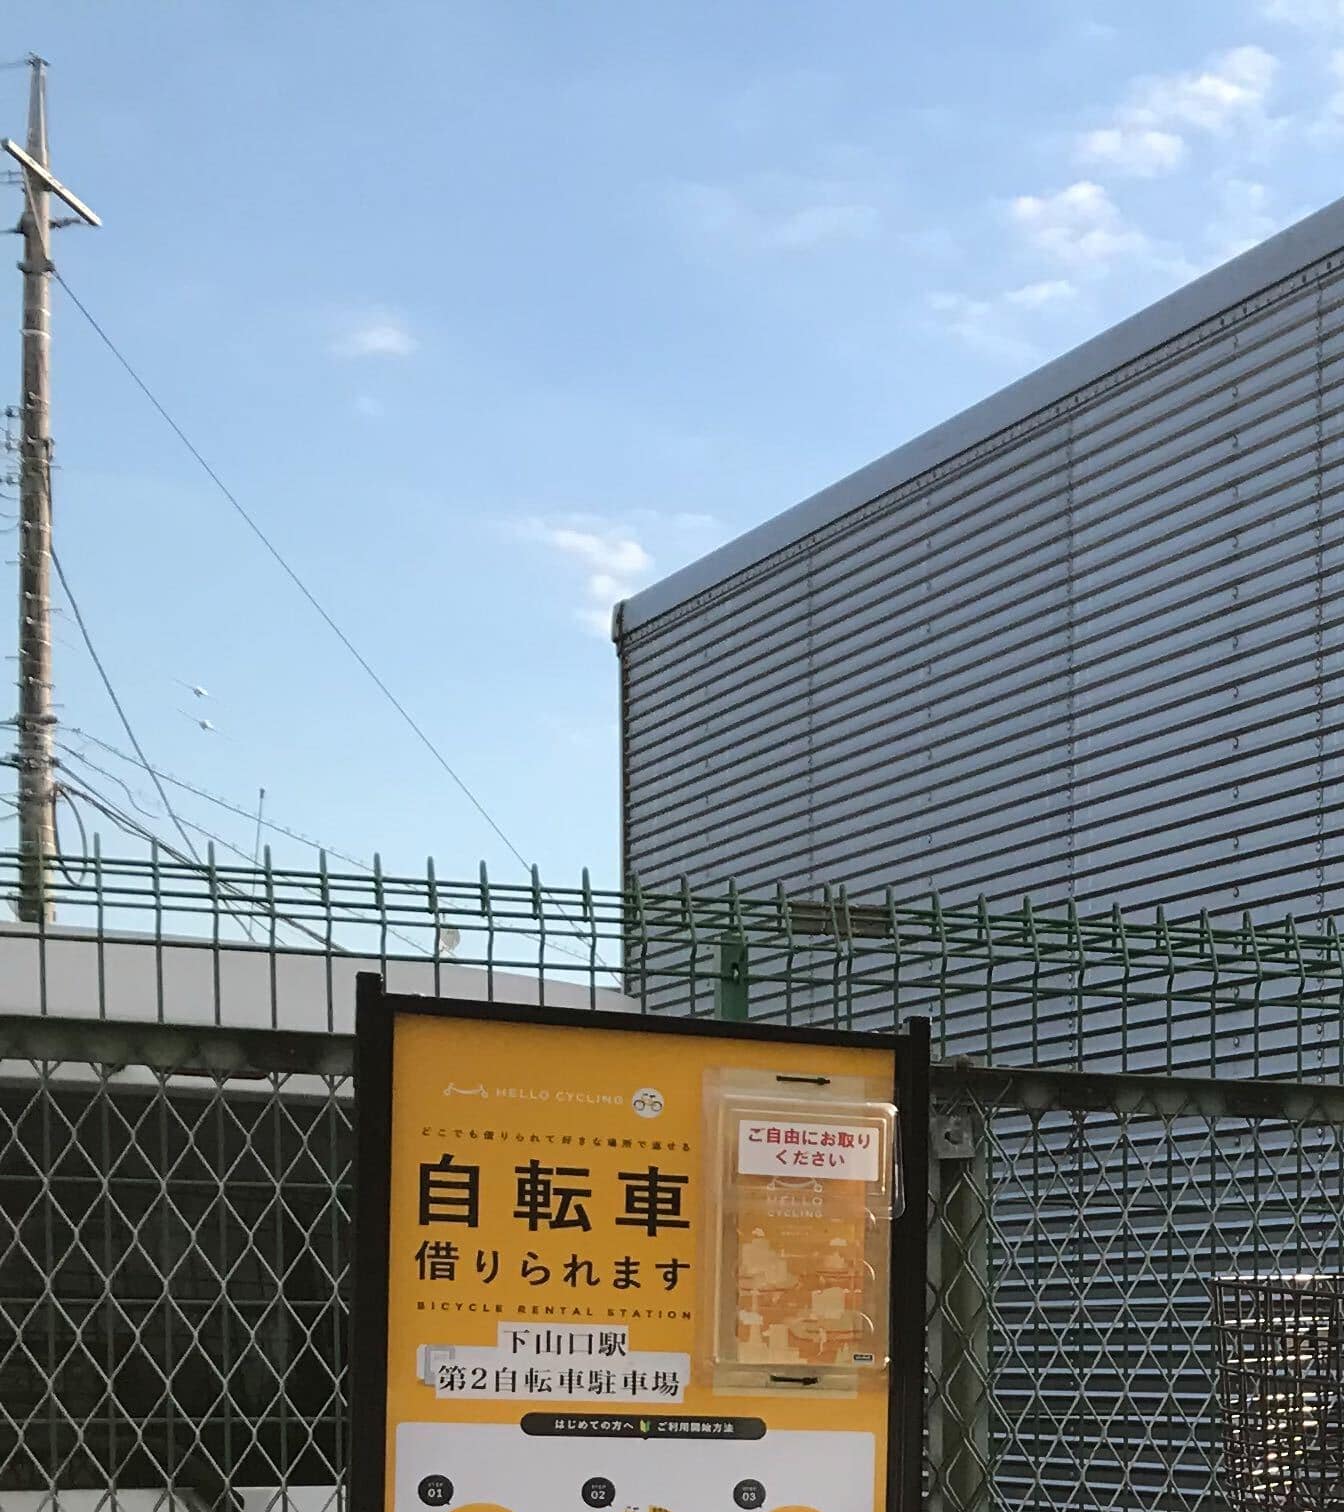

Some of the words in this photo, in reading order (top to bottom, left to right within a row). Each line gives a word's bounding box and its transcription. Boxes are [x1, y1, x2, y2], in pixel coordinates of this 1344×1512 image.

[496, 1088, 549, 1101] HELLO
[556, 1091, 625, 1105] CYCLING
[748, 1127, 871, 1149] ご自由にお取り
[776, 1149, 845, 1167] ください
[419, 1153, 690, 1237] 自転車
[415, 1240, 691, 1291] 借りられます
[417, 1301, 503, 1314] BICYCLE
[517, 1305, 594, 1318] RENTAL
[607, 1308, 692, 1321] STATION
[503, 1329, 627, 1357] 下山口駅
[438, 1364, 680, 1397] 第2自転車駐車場
[555, 1419, 634, 1431] はじめての方へ
[427, 1488, 443, 1498] 01
[590, 1490, 606, 1500] 02
[742, 1492, 756, 1502] 03
